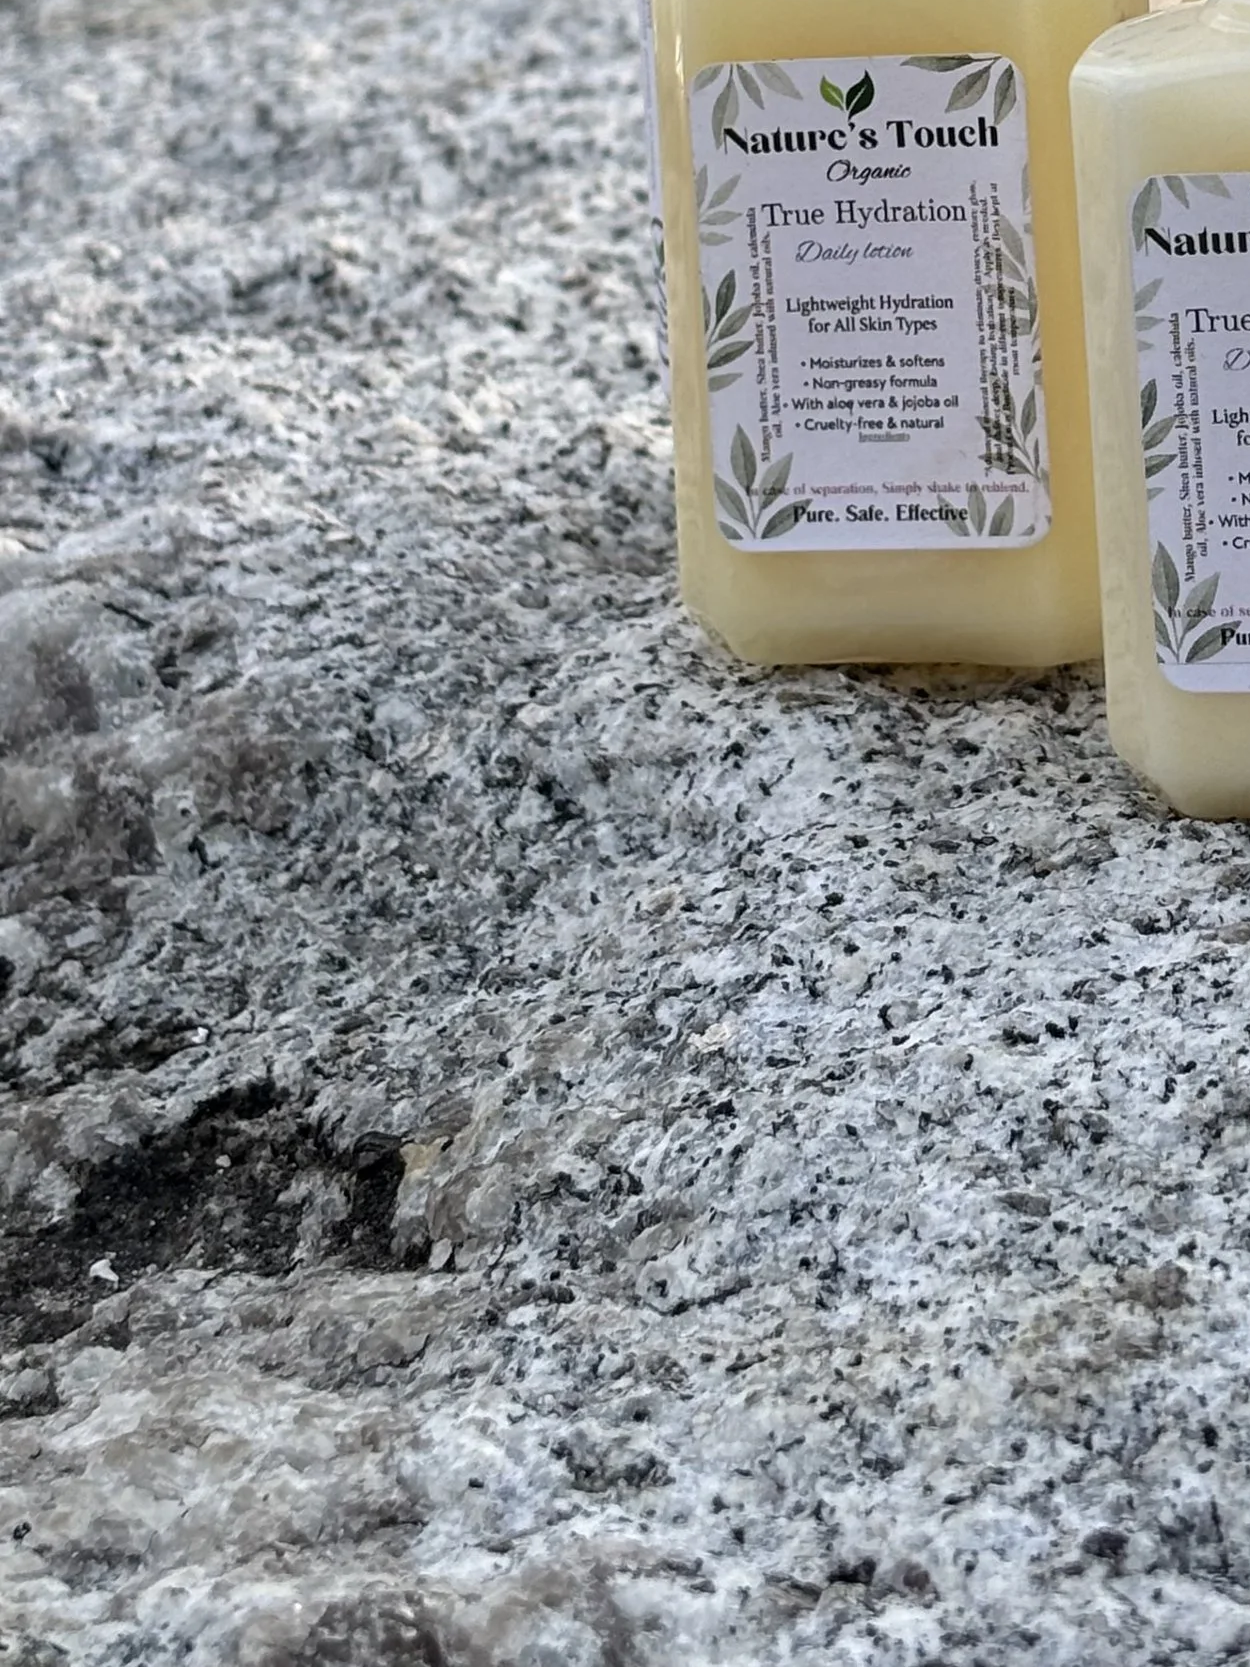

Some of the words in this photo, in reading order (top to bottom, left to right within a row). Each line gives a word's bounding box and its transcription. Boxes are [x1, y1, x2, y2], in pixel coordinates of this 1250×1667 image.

[723, 122, 879, 155] Nature's
[886, 117, 999, 149] Touch
[826, 159, 912, 186] Organic
[761, 202, 825, 227] True
[835, 197, 968, 229] Hydration
[795, 240, 860, 265] Daily
[863, 241, 914, 260] lotion
[785, 295, 876, 317] Lightweight
[879, 293, 954, 314] Hydration
[808, 318, 831, 333] for
[833, 316, 856, 332] All
[859, 315, 893, 332] Skin
[895, 316, 938, 335] Types
[809, 355, 883, 370] Moisturizes
[885, 355, 896, 368] &
[899, 354, 945, 368] softens
[812, 376, 887, 392] Non-greasy
[889, 374, 938, 388] formula
[1185, 365, 1199, 406] natural
[791, 397, 824, 411] With
[857, 399, 886, 409] vera
[888, 396, 899, 409] &
[901, 394, 941, 411] jojoba
[943, 394, 959, 408] oil
[804, 416, 884, 433] Cruelty-free
[887, 416, 898, 429] &
[900, 416, 944, 430] natural
[793, 483, 806, 495] of
[810, 482, 878, 497] separation,
[882, 482, 923, 496] Simply
[927, 481, 961, 494] shake
[792, 505, 841, 522] Pure.
[845, 505, 890, 522] Safe.
[896, 504, 969, 522] Effective
[1195, 509, 1207, 533] Aloe
[1184, 544, 1197, 582] Mango
[1220, 605, 1234, 617] of
